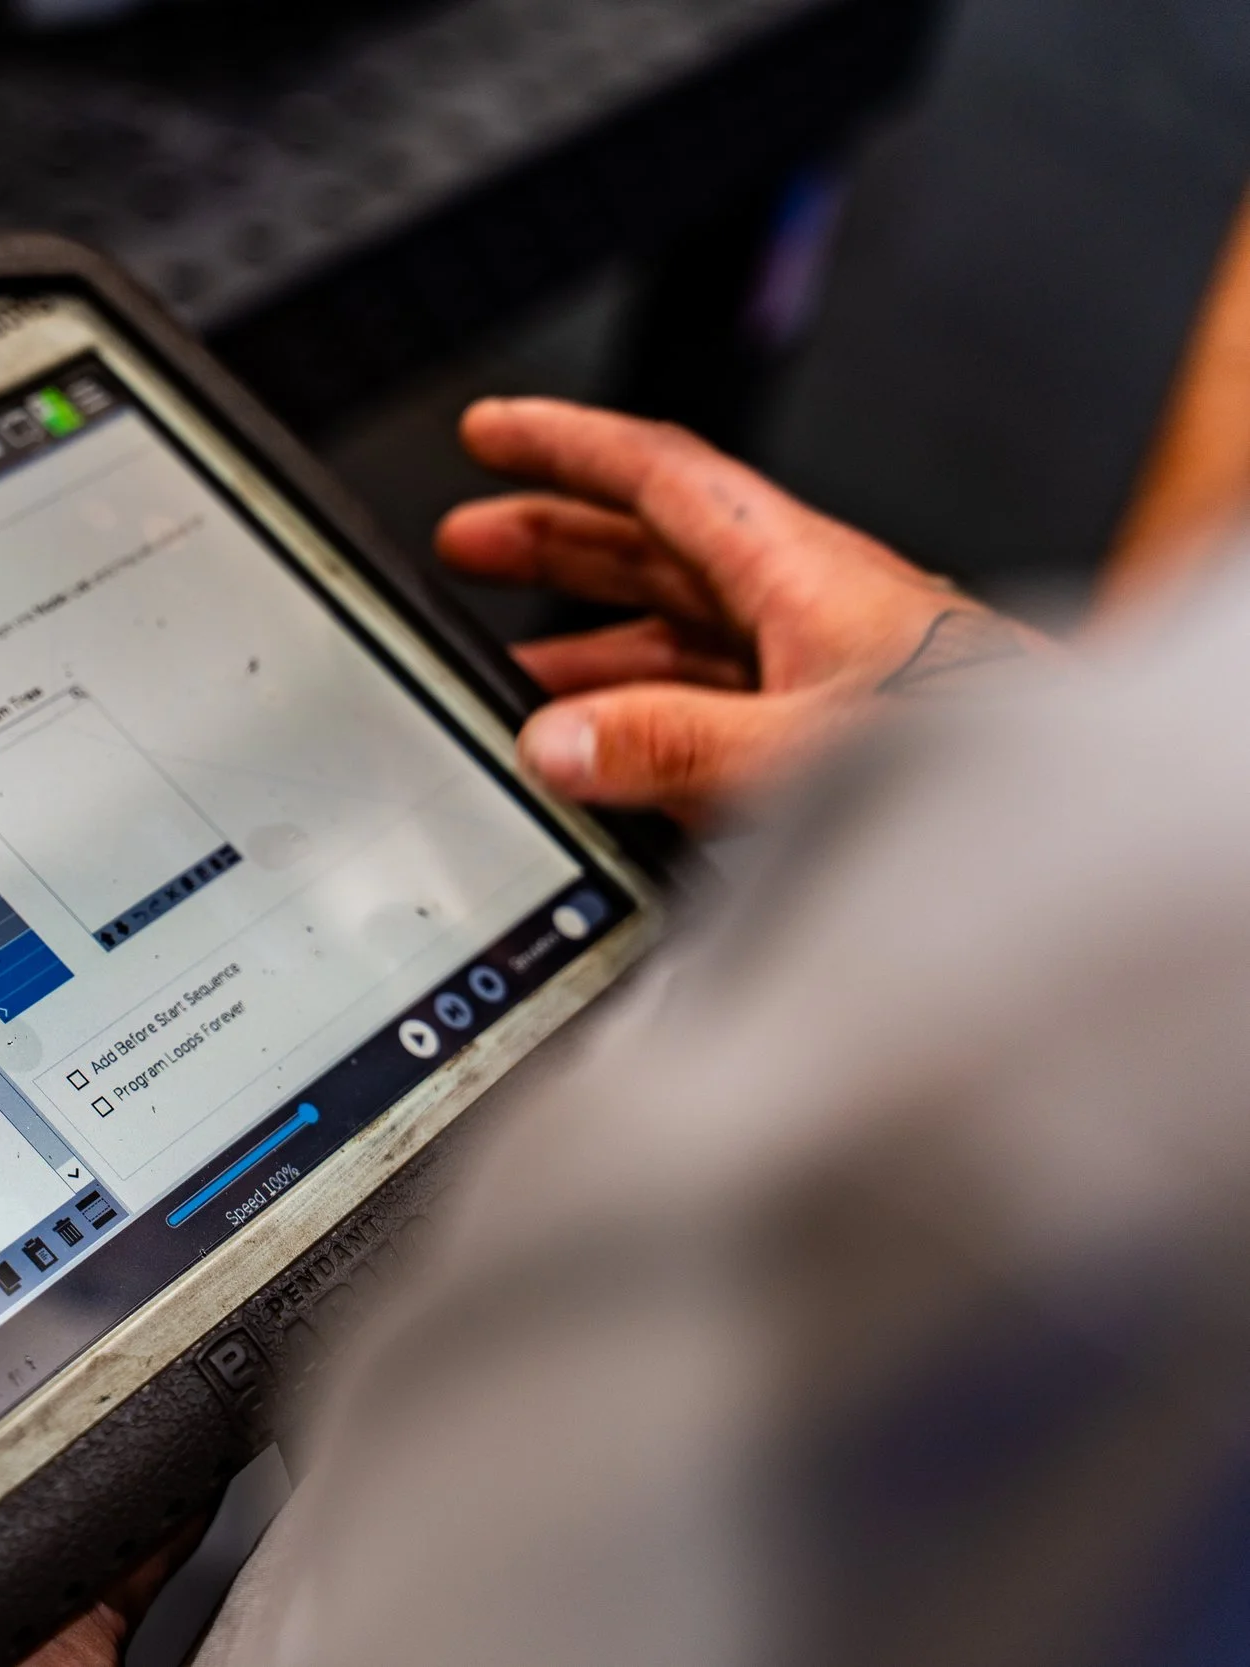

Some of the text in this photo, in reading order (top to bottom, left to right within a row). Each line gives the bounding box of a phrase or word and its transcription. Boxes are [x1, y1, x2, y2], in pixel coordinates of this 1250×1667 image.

[8, 687, 44, 707] Tree
[91, 962, 241, 1075] Add Before Start Sequence
[113, 999, 247, 1101] Program Loops Forever
[225, 1163, 301, 1226] Speed 100%
[265, 1217, 384, 1320] PENDANT
